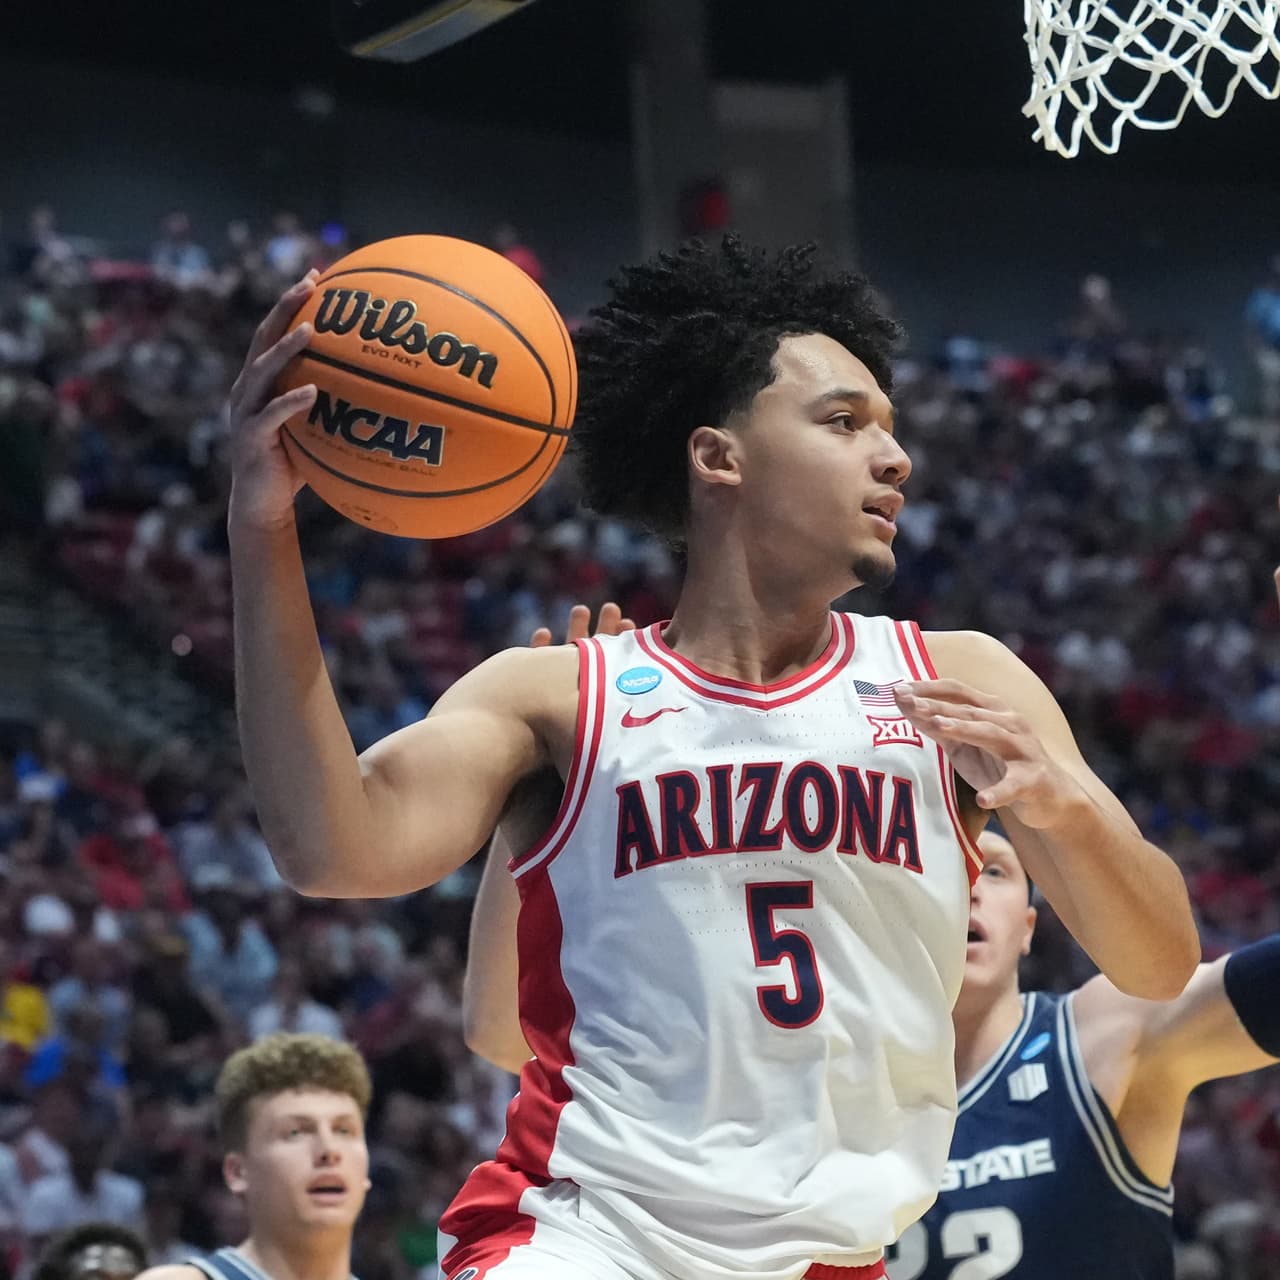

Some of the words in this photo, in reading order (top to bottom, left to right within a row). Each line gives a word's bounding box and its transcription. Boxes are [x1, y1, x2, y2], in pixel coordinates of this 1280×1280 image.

[314, 288, 499, 390] Wilson
[361, 344, 390, 358] EVO
[308, 389, 445, 467] NCAA
[614, 760, 923, 879] ARIZONA
[744, 880, 824, 1030] 5
[939, 1138, 1056, 1193] STATE
